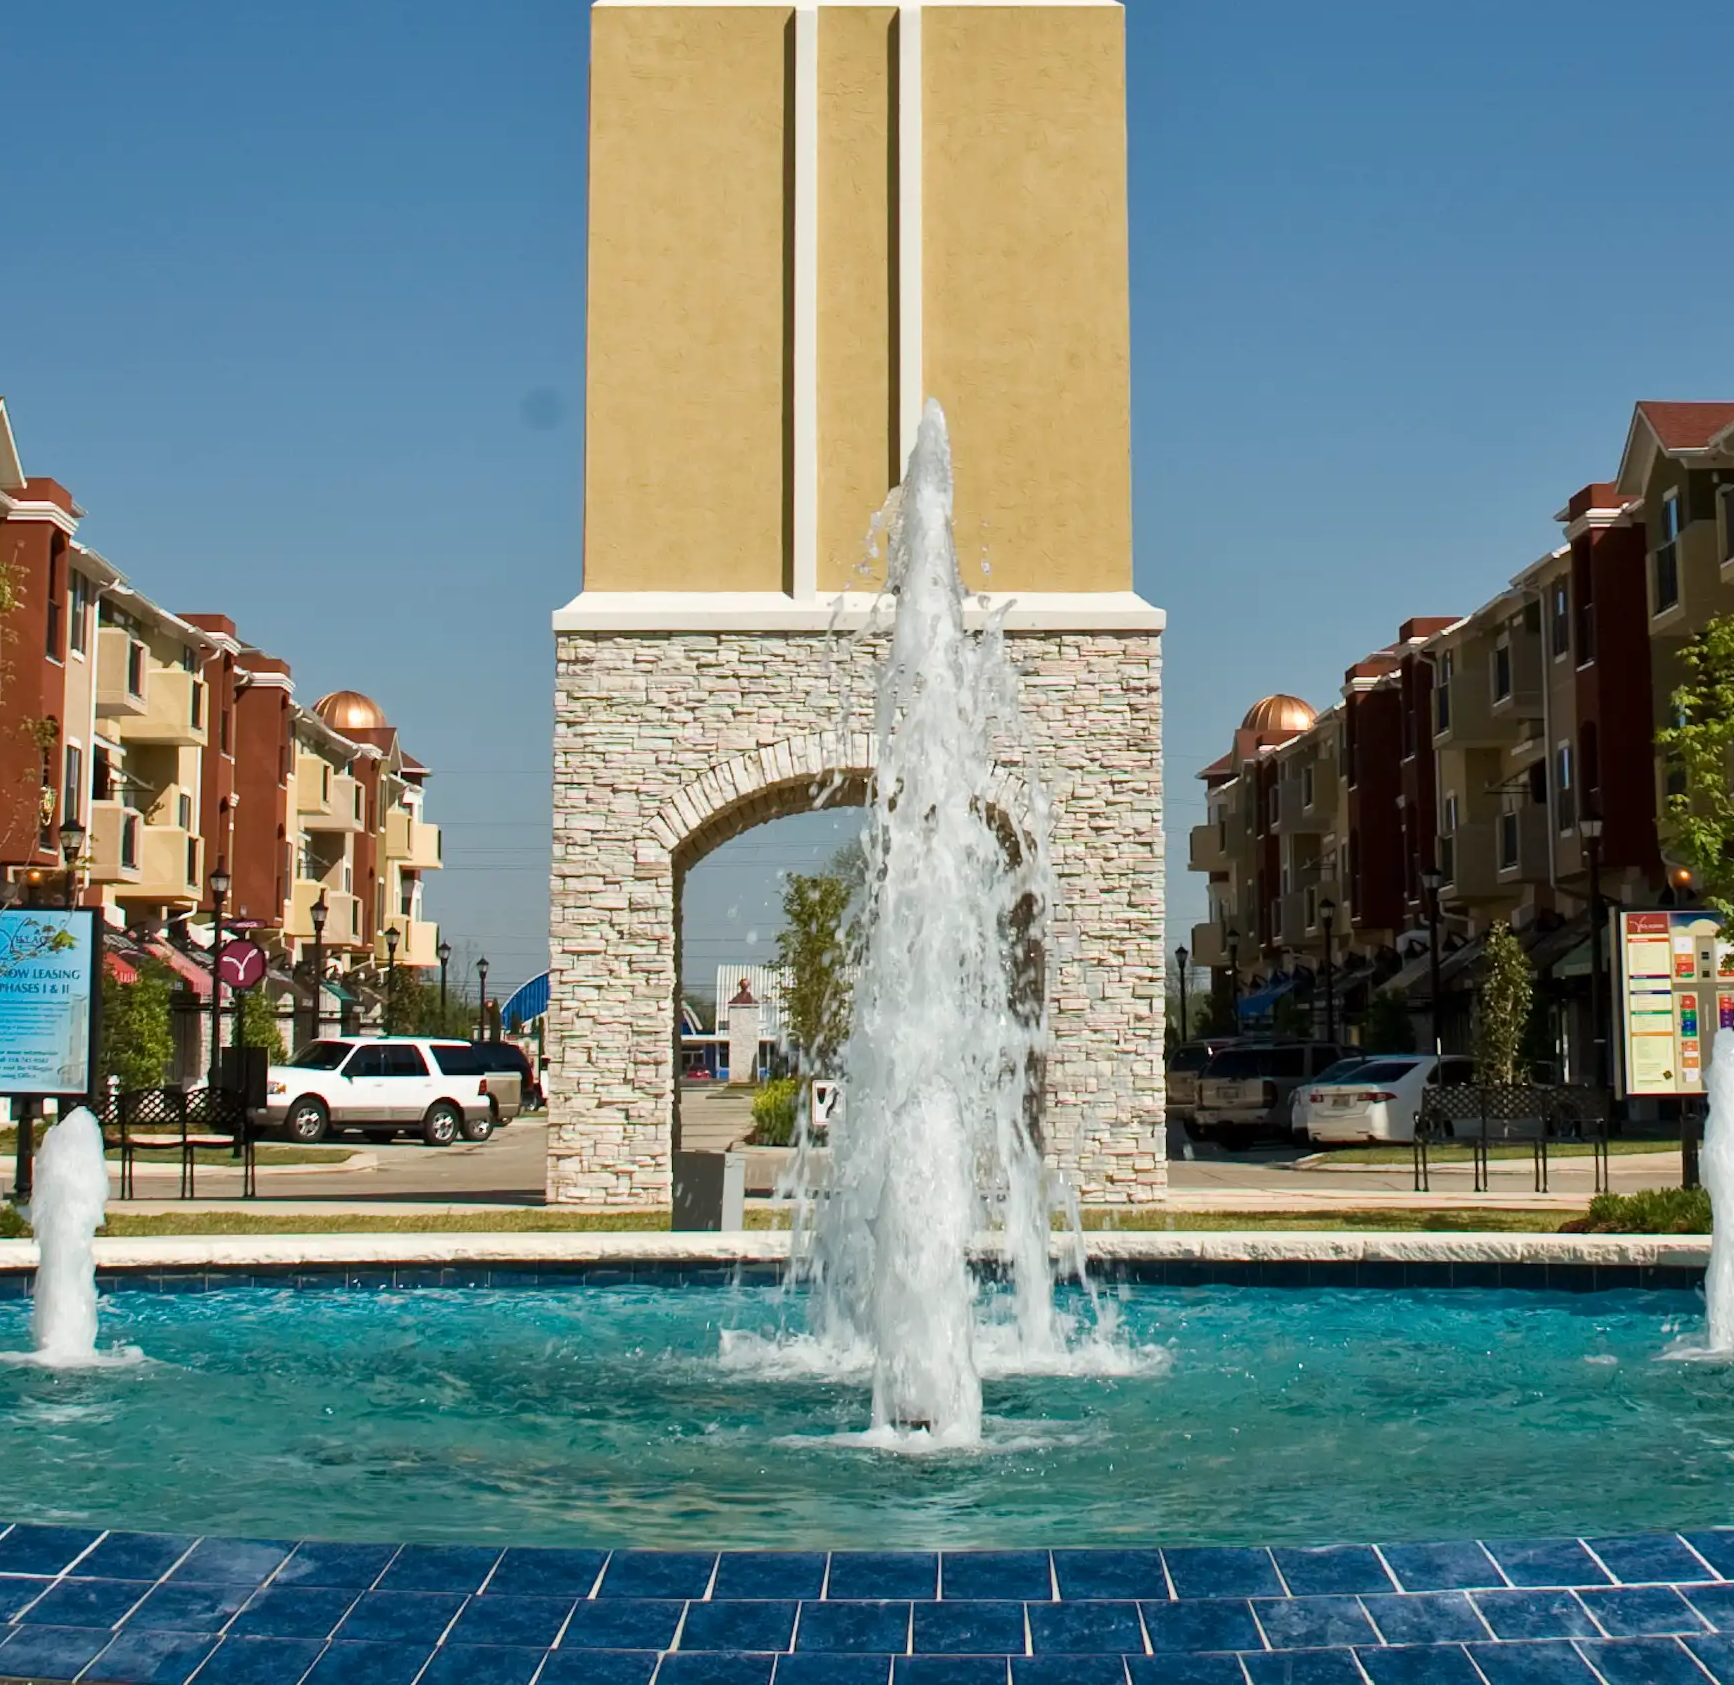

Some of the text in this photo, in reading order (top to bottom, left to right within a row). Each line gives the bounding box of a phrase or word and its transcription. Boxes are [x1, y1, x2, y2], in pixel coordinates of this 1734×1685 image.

[33, 969, 81, 980] LEASING
[43, 984, 47, 994] I
[50, 984, 58, 994] &
[62, 984, 70, 995] II
